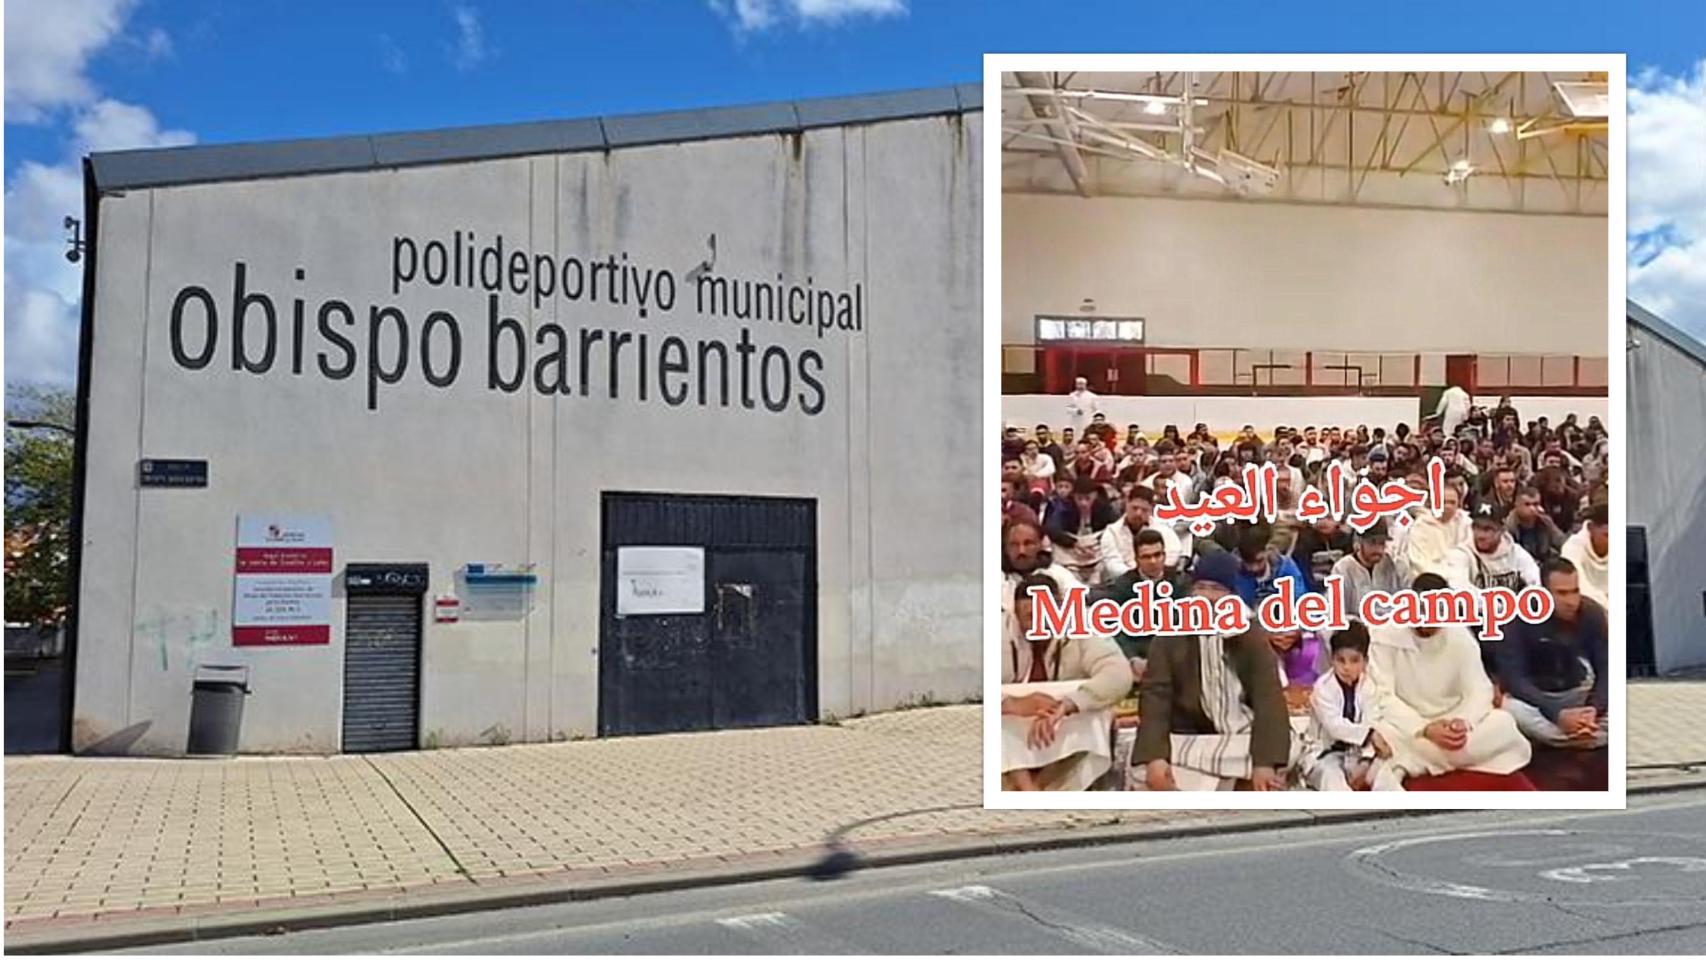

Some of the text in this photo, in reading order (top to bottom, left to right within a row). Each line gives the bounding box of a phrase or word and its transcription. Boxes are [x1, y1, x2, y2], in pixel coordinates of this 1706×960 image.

[169, 261, 827, 416] obispo barrientos
[393, 230, 863, 332] polideportivo municipal
